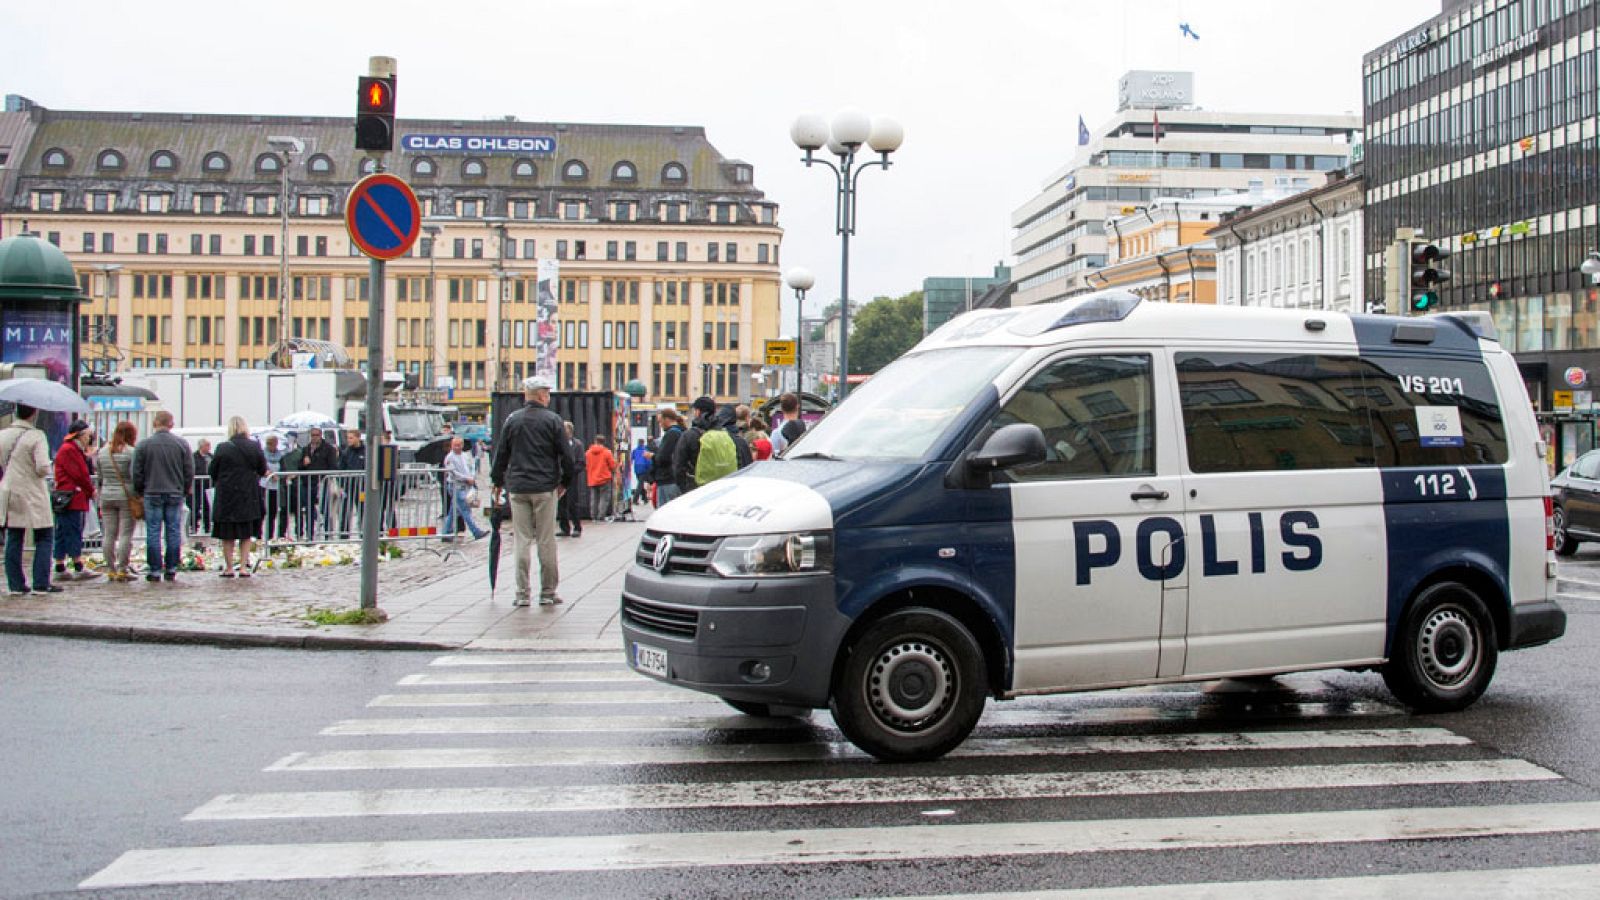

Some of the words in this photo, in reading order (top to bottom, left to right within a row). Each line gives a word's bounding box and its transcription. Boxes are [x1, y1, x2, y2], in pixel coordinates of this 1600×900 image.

[410, 136, 462, 148] CLAS
[467, 138, 549, 151] OHLSON
[1397, 375, 1426, 393] VS
[1429, 376, 1464, 395] 201
[1414, 474, 1456, 496] 112
[1072, 510, 1323, 587] POLIS
